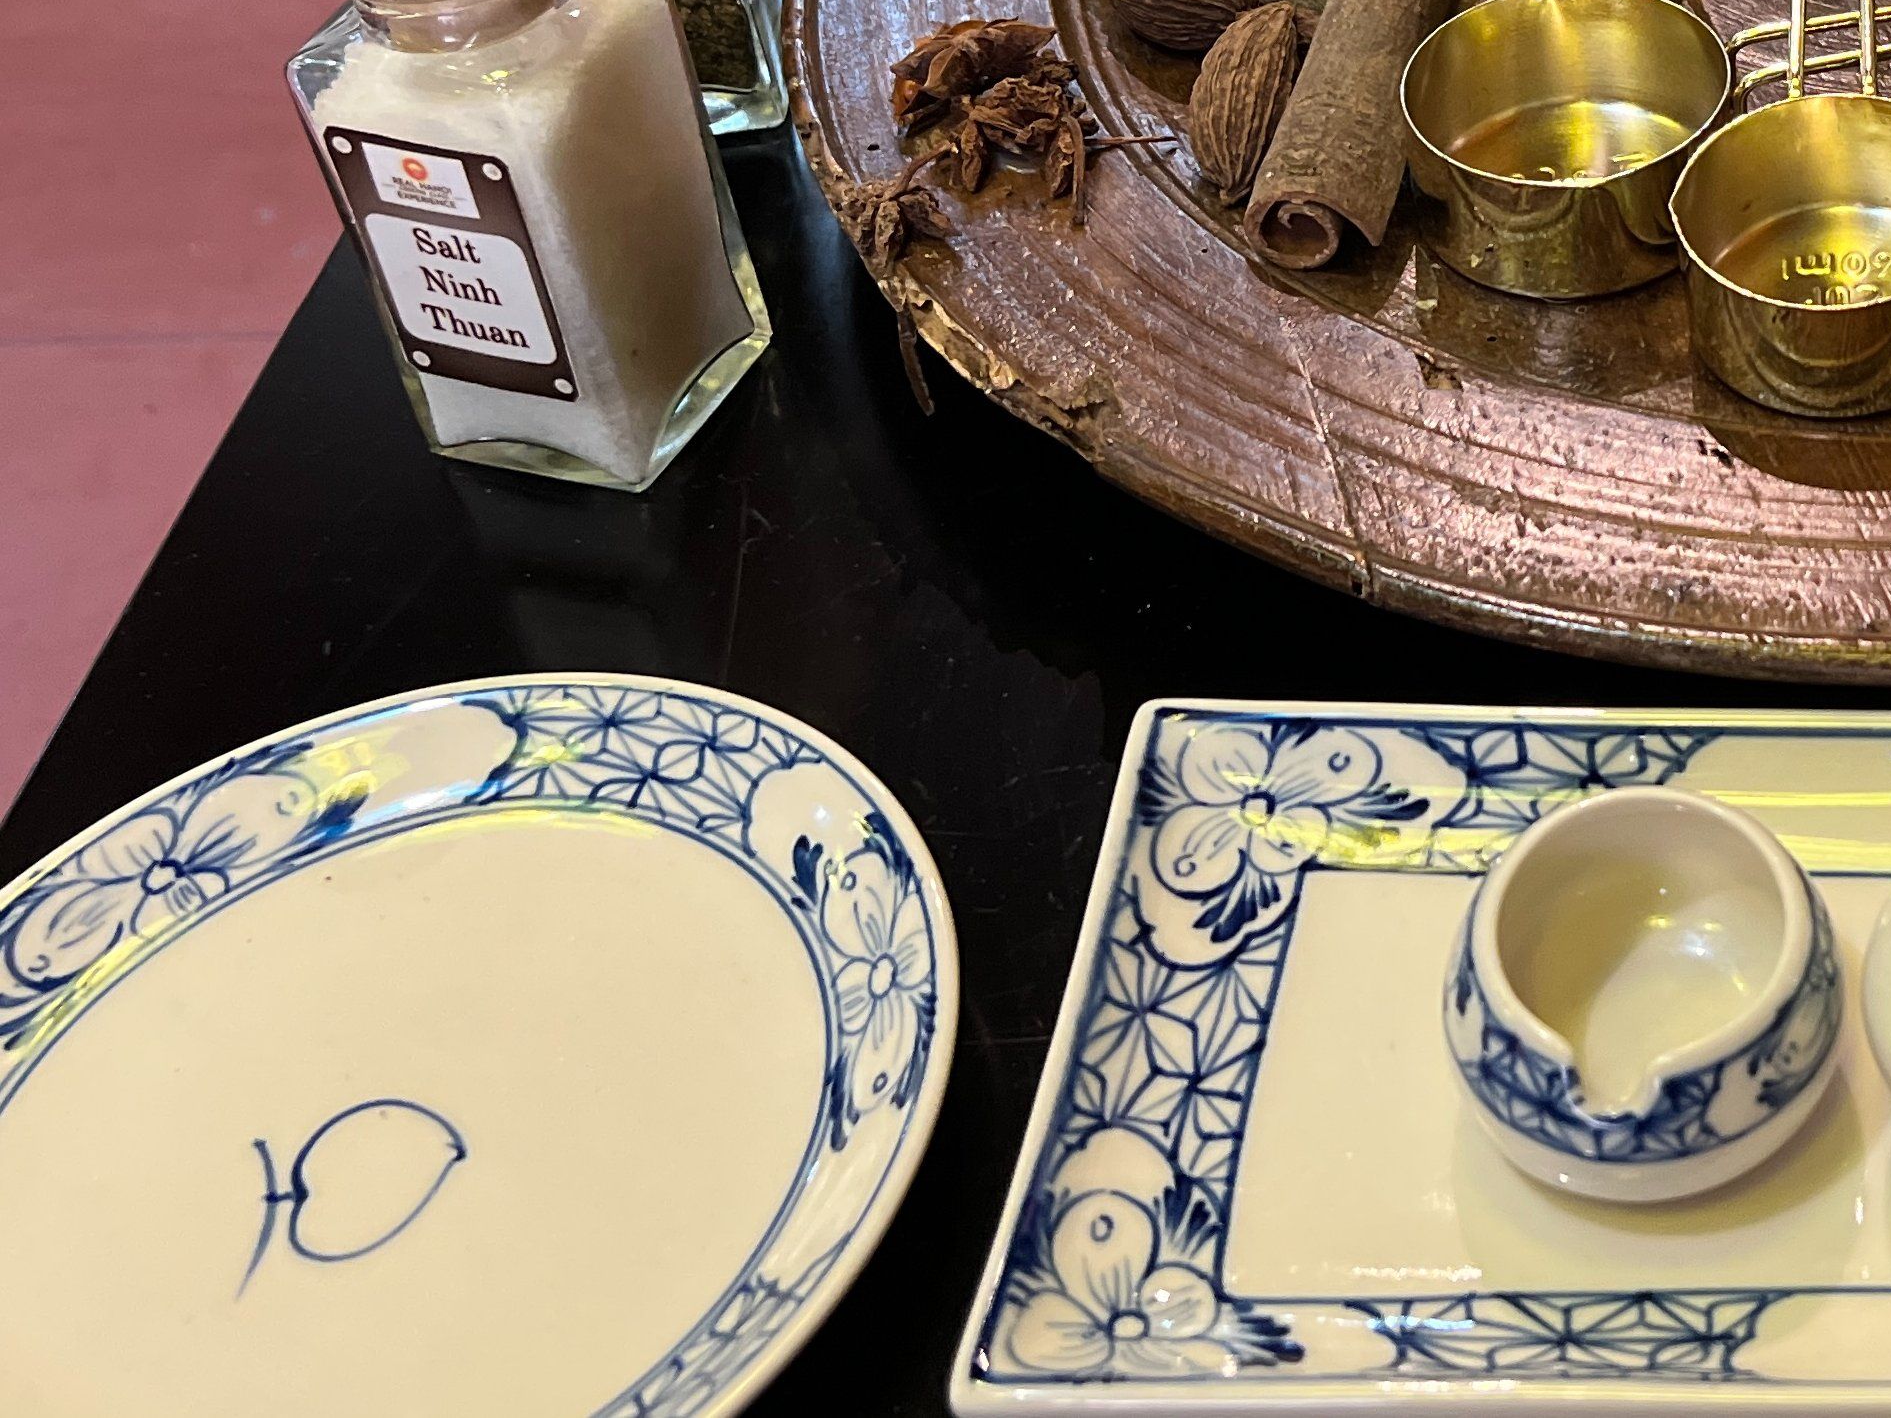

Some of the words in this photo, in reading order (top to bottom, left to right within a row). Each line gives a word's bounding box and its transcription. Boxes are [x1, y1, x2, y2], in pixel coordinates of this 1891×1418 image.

[412, 227, 481, 264] Salt
[419, 265, 502, 306] Ninh
[420, 302, 530, 348] Thuan
